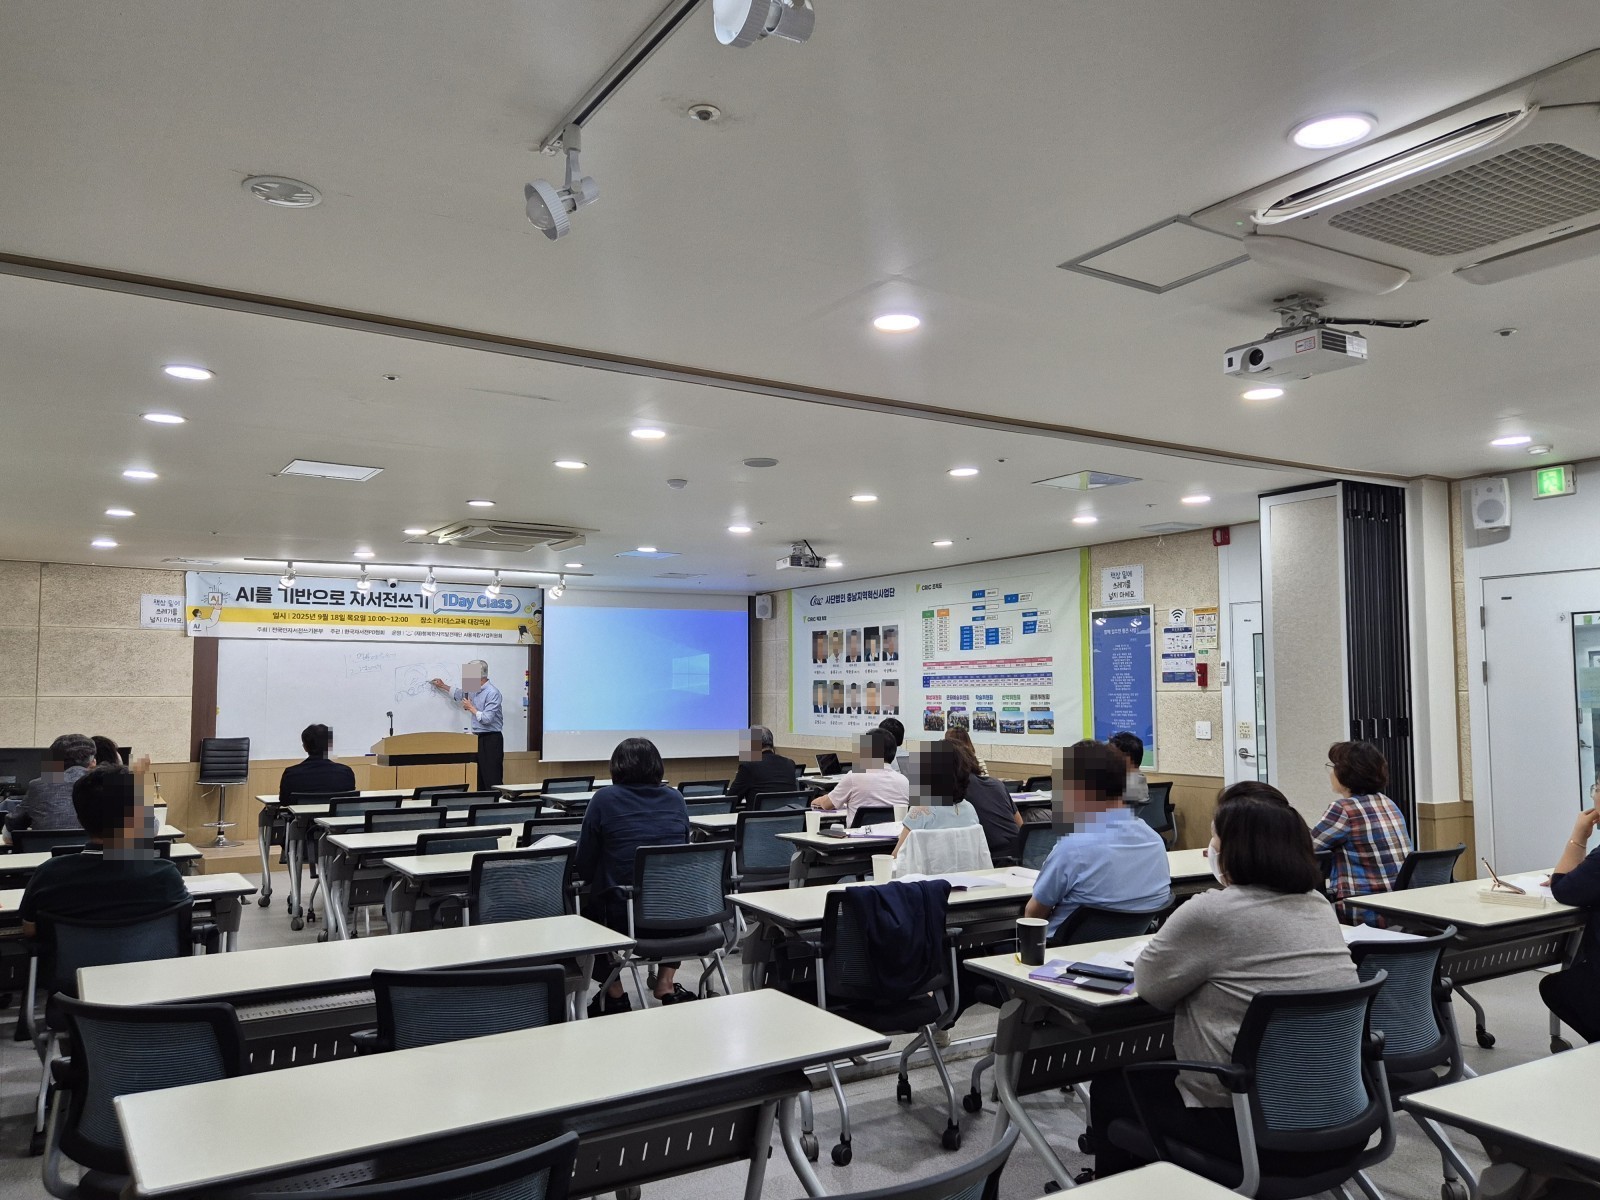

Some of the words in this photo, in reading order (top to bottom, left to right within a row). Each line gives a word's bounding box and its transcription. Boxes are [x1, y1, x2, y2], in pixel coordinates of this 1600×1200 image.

[1113, 579, 1131, 589] 쓰레기를
[235, 586, 273, 604] AI를
[278, 587, 346, 606] 기반으로
[350, 590, 429, 609] 자서전쓰기
[441, 593, 474, 610] 1Day
[476, 594, 513, 609] Class
[825, 594, 846, 605] 사단법인
[156, 607, 178, 616] 쓰레기를
[149, 616, 162, 624] 넣지
[292, 612, 316, 621] 2025년
[317, 613, 329, 621] 9월
[330, 614, 345, 622] 18일
[347, 614, 367, 622] 목요일
[367, 615, 409, 623] 10:00~12:00
[420, 616, 433, 624] 장소
[467, 618, 491, 626] 대강의실
